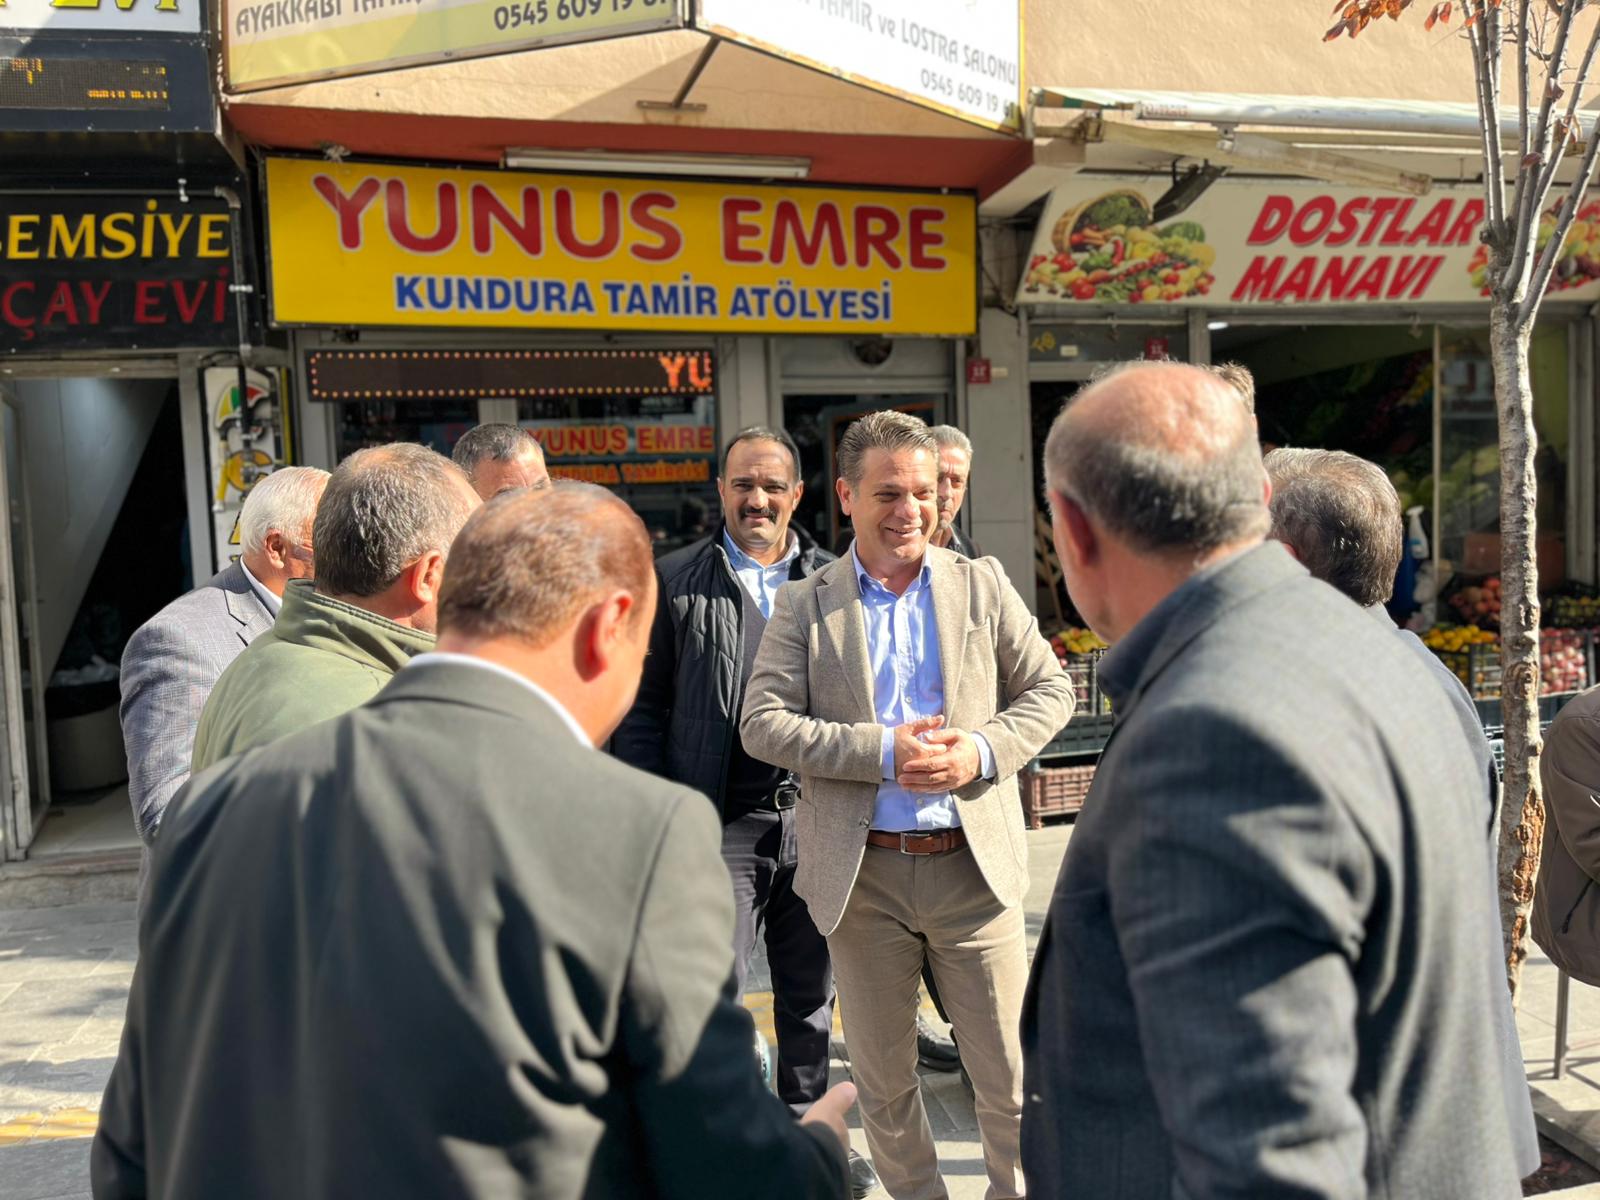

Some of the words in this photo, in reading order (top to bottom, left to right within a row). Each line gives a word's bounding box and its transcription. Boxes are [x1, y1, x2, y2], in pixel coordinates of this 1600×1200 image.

[494, 0, 548, 30] 0545
[877, 14, 896, 39] ve
[901, 18, 958, 64] LOSTRA
[963, 44, 1017, 87] SALONU
[920, 67, 954, 96] 0545
[957, 82, 983, 107] 609
[986, 91, 998, 112] 19
[0, 199, 230, 260] EMSİYE
[313, 175, 682, 262] YUNUS
[722, 197, 947, 270] EMRE
[1246, 195, 1486, 246] DOSTLAR
[396, 275, 595, 313] KUNDURA
[603, 273, 718, 317] TAMİR
[730, 280, 891, 320] ATÖLYESİ
[1230, 255, 1446, 301] MANAVI
[0, 280, 112, 340] ÇAY
[134, 265, 229, 325] EVİ
[659, 354, 713, 389] YU
[527, 426, 629, 456] YUNUS
[637, 425, 714, 453] EMRE
